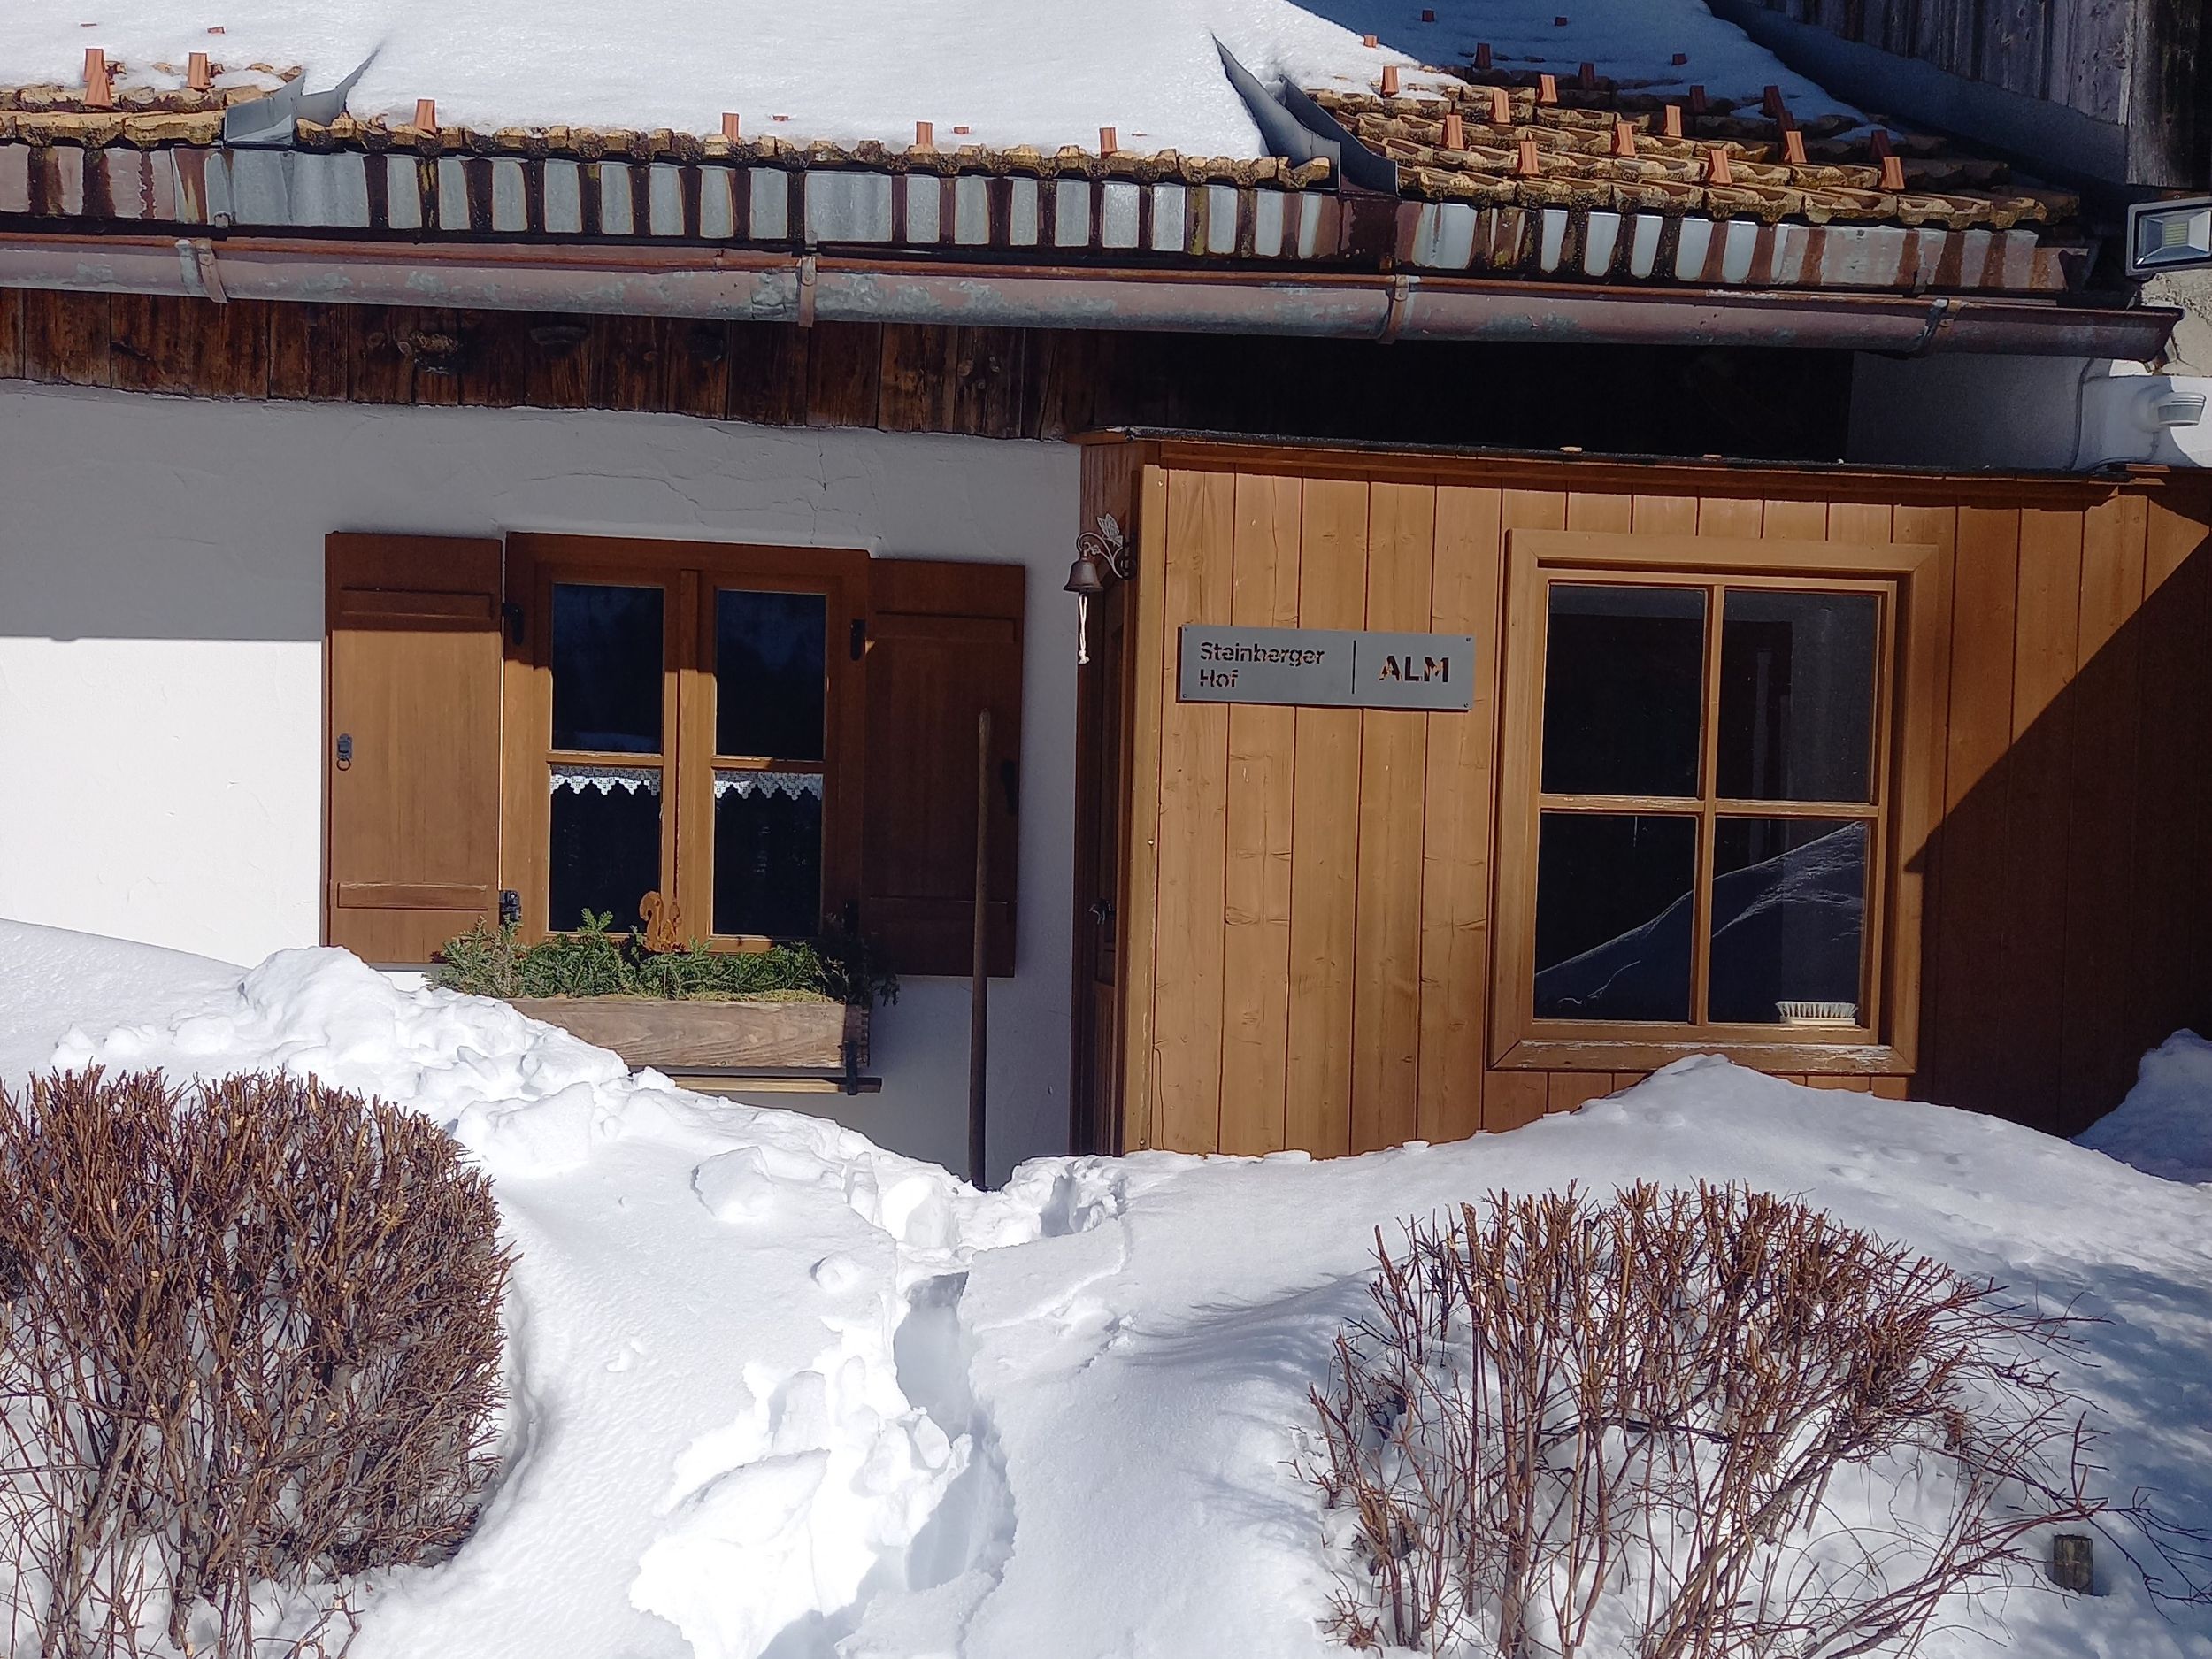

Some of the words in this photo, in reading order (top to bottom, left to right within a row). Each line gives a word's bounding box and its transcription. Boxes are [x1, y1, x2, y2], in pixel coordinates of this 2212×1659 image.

[1200, 641, 1325, 667] Steinberger
[1199, 668, 1239, 688] Hof
[1379, 655, 1450, 683] ALM
